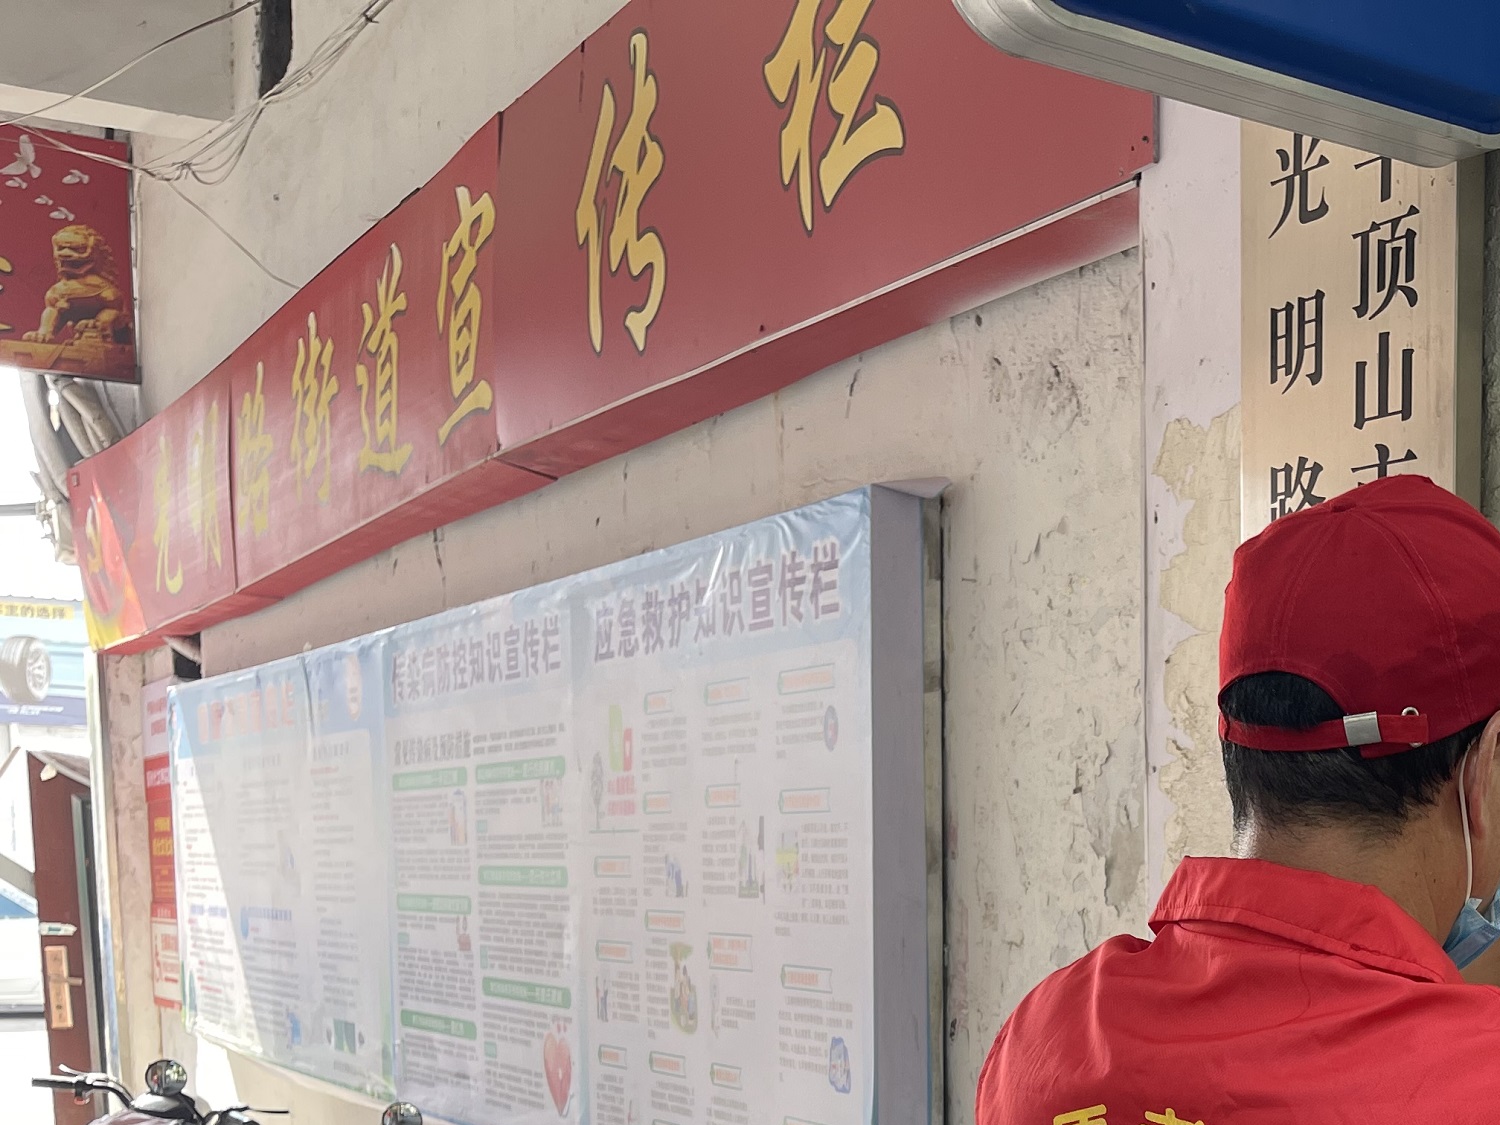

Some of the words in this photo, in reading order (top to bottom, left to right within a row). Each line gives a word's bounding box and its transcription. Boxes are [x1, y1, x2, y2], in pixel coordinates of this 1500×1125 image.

[593, 541, 842, 664] 应急救护知识宣传栏
[391, 614, 563, 704] 传染病防控知识宣传栏
